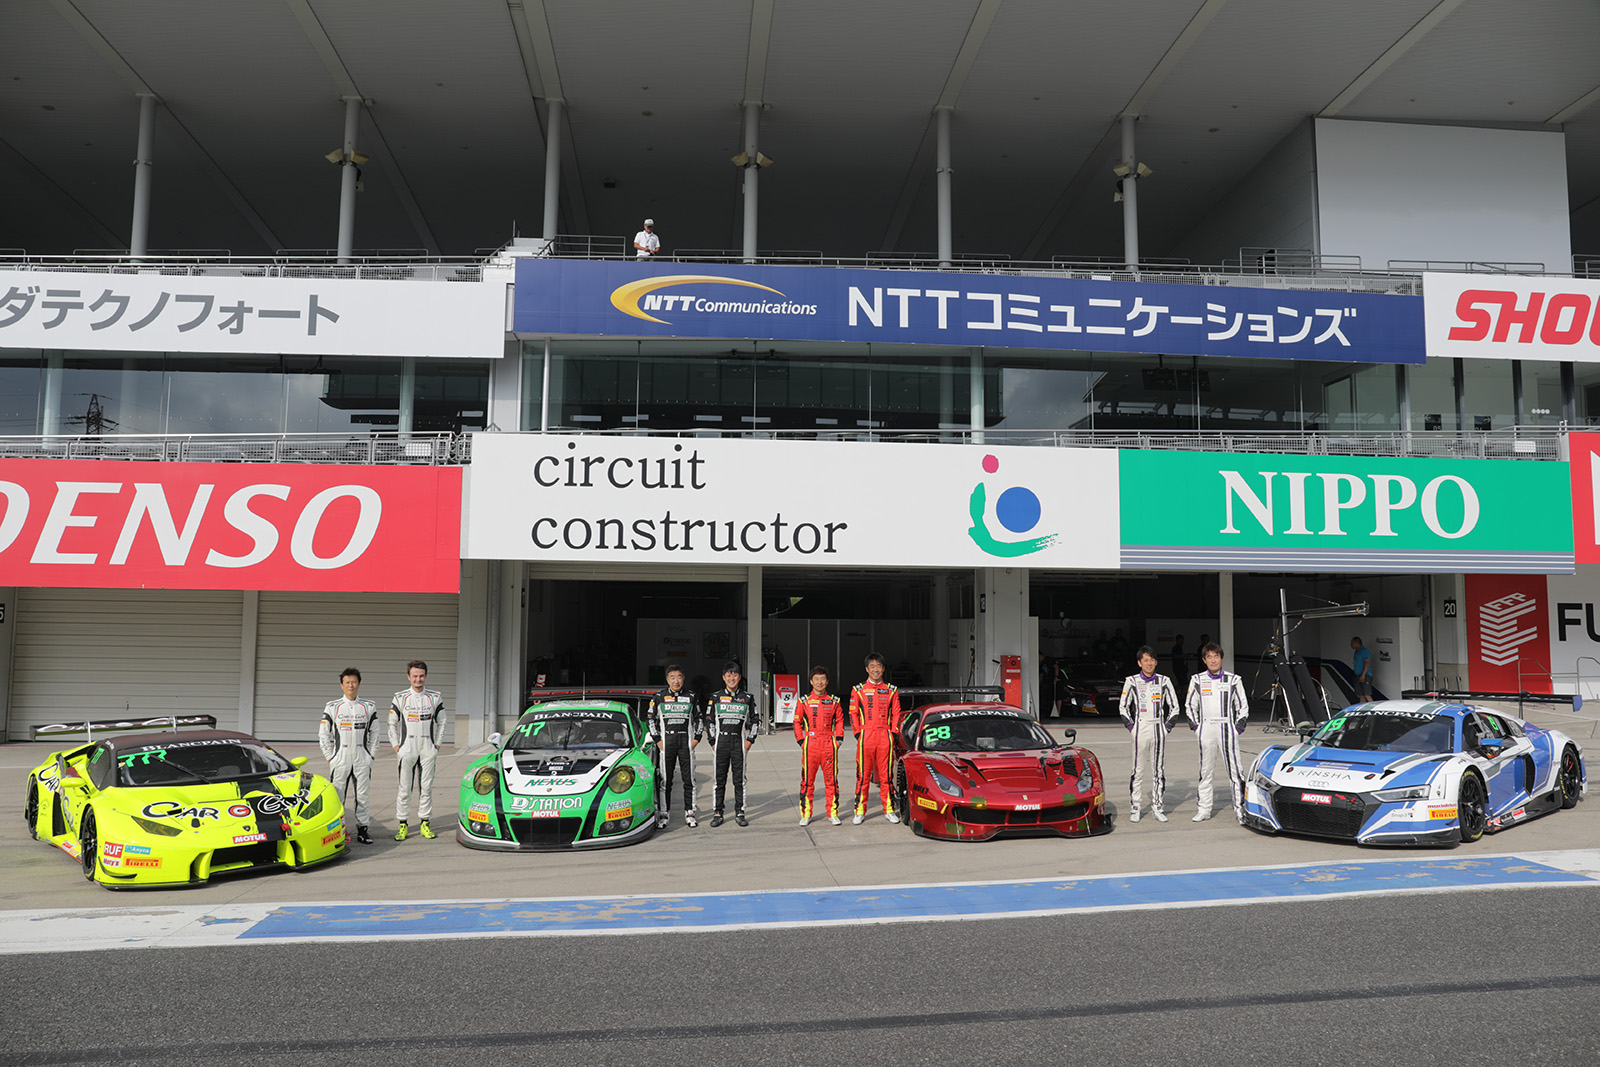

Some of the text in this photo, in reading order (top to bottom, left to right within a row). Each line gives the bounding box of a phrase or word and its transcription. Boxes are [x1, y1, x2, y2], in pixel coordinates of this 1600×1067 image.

[643, 295, 817, 315] NTT Communications
[849, 286, 1357, 347] NTTコミュニケーションズ
[1448, 289, 1600, 346] SHO
[533, 442, 706, 490] circuit
[1219, 470, 1480, 539] NIPPO
[531, 510, 847, 553] constructor
[1445, 603, 1456, 615] 20
[784, 693, 791, 702] 8
[941, 711, 1019, 720] BLANCPAIN
[1344, 711, 1436, 720] BLANCPAIN
[520, 721, 545, 737] 47
[1322, 718, 1347, 732] 19
[925, 726, 950, 743] 28
[142, 738, 241, 752] BLANCPAIN
[117, 749, 168, 768] 777
[524, 779, 577, 788] NEXUS
[1302, 794, 1331, 803] MOTUL
[234, 834, 266, 844] MOTUL
[104, 844, 123, 856] RUF
[125, 859, 159, 867] PIRELLI
